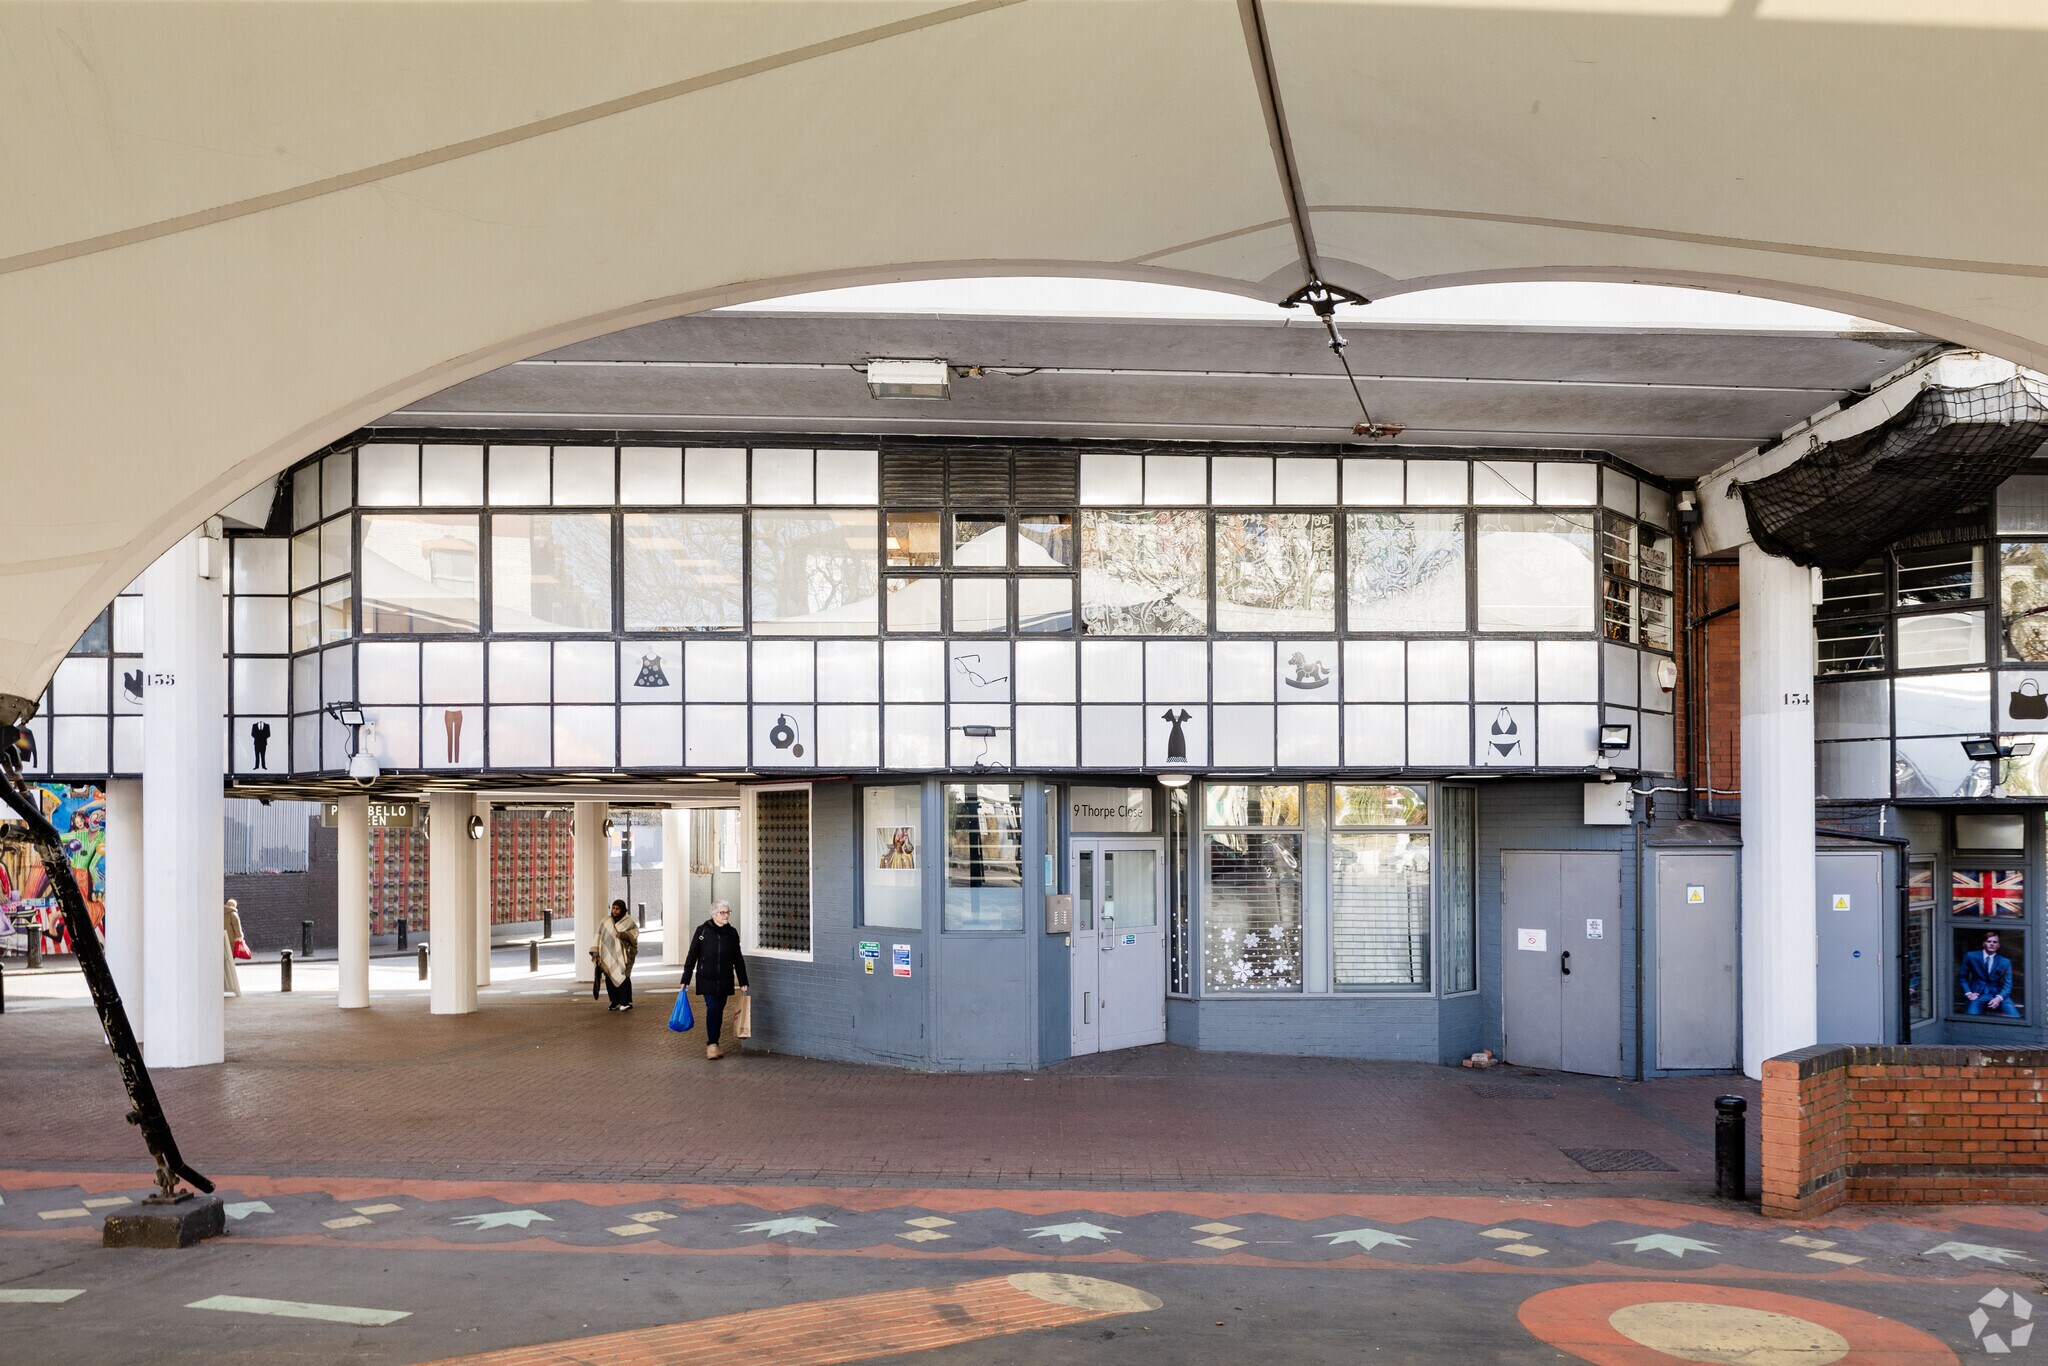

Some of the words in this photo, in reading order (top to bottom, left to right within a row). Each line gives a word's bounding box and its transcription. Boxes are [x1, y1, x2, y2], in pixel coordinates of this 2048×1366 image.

[1073, 804, 1080, 816] 9
[1081, 804, 1115, 819] Thorpe
[1118, 805, 1143, 817] Close
